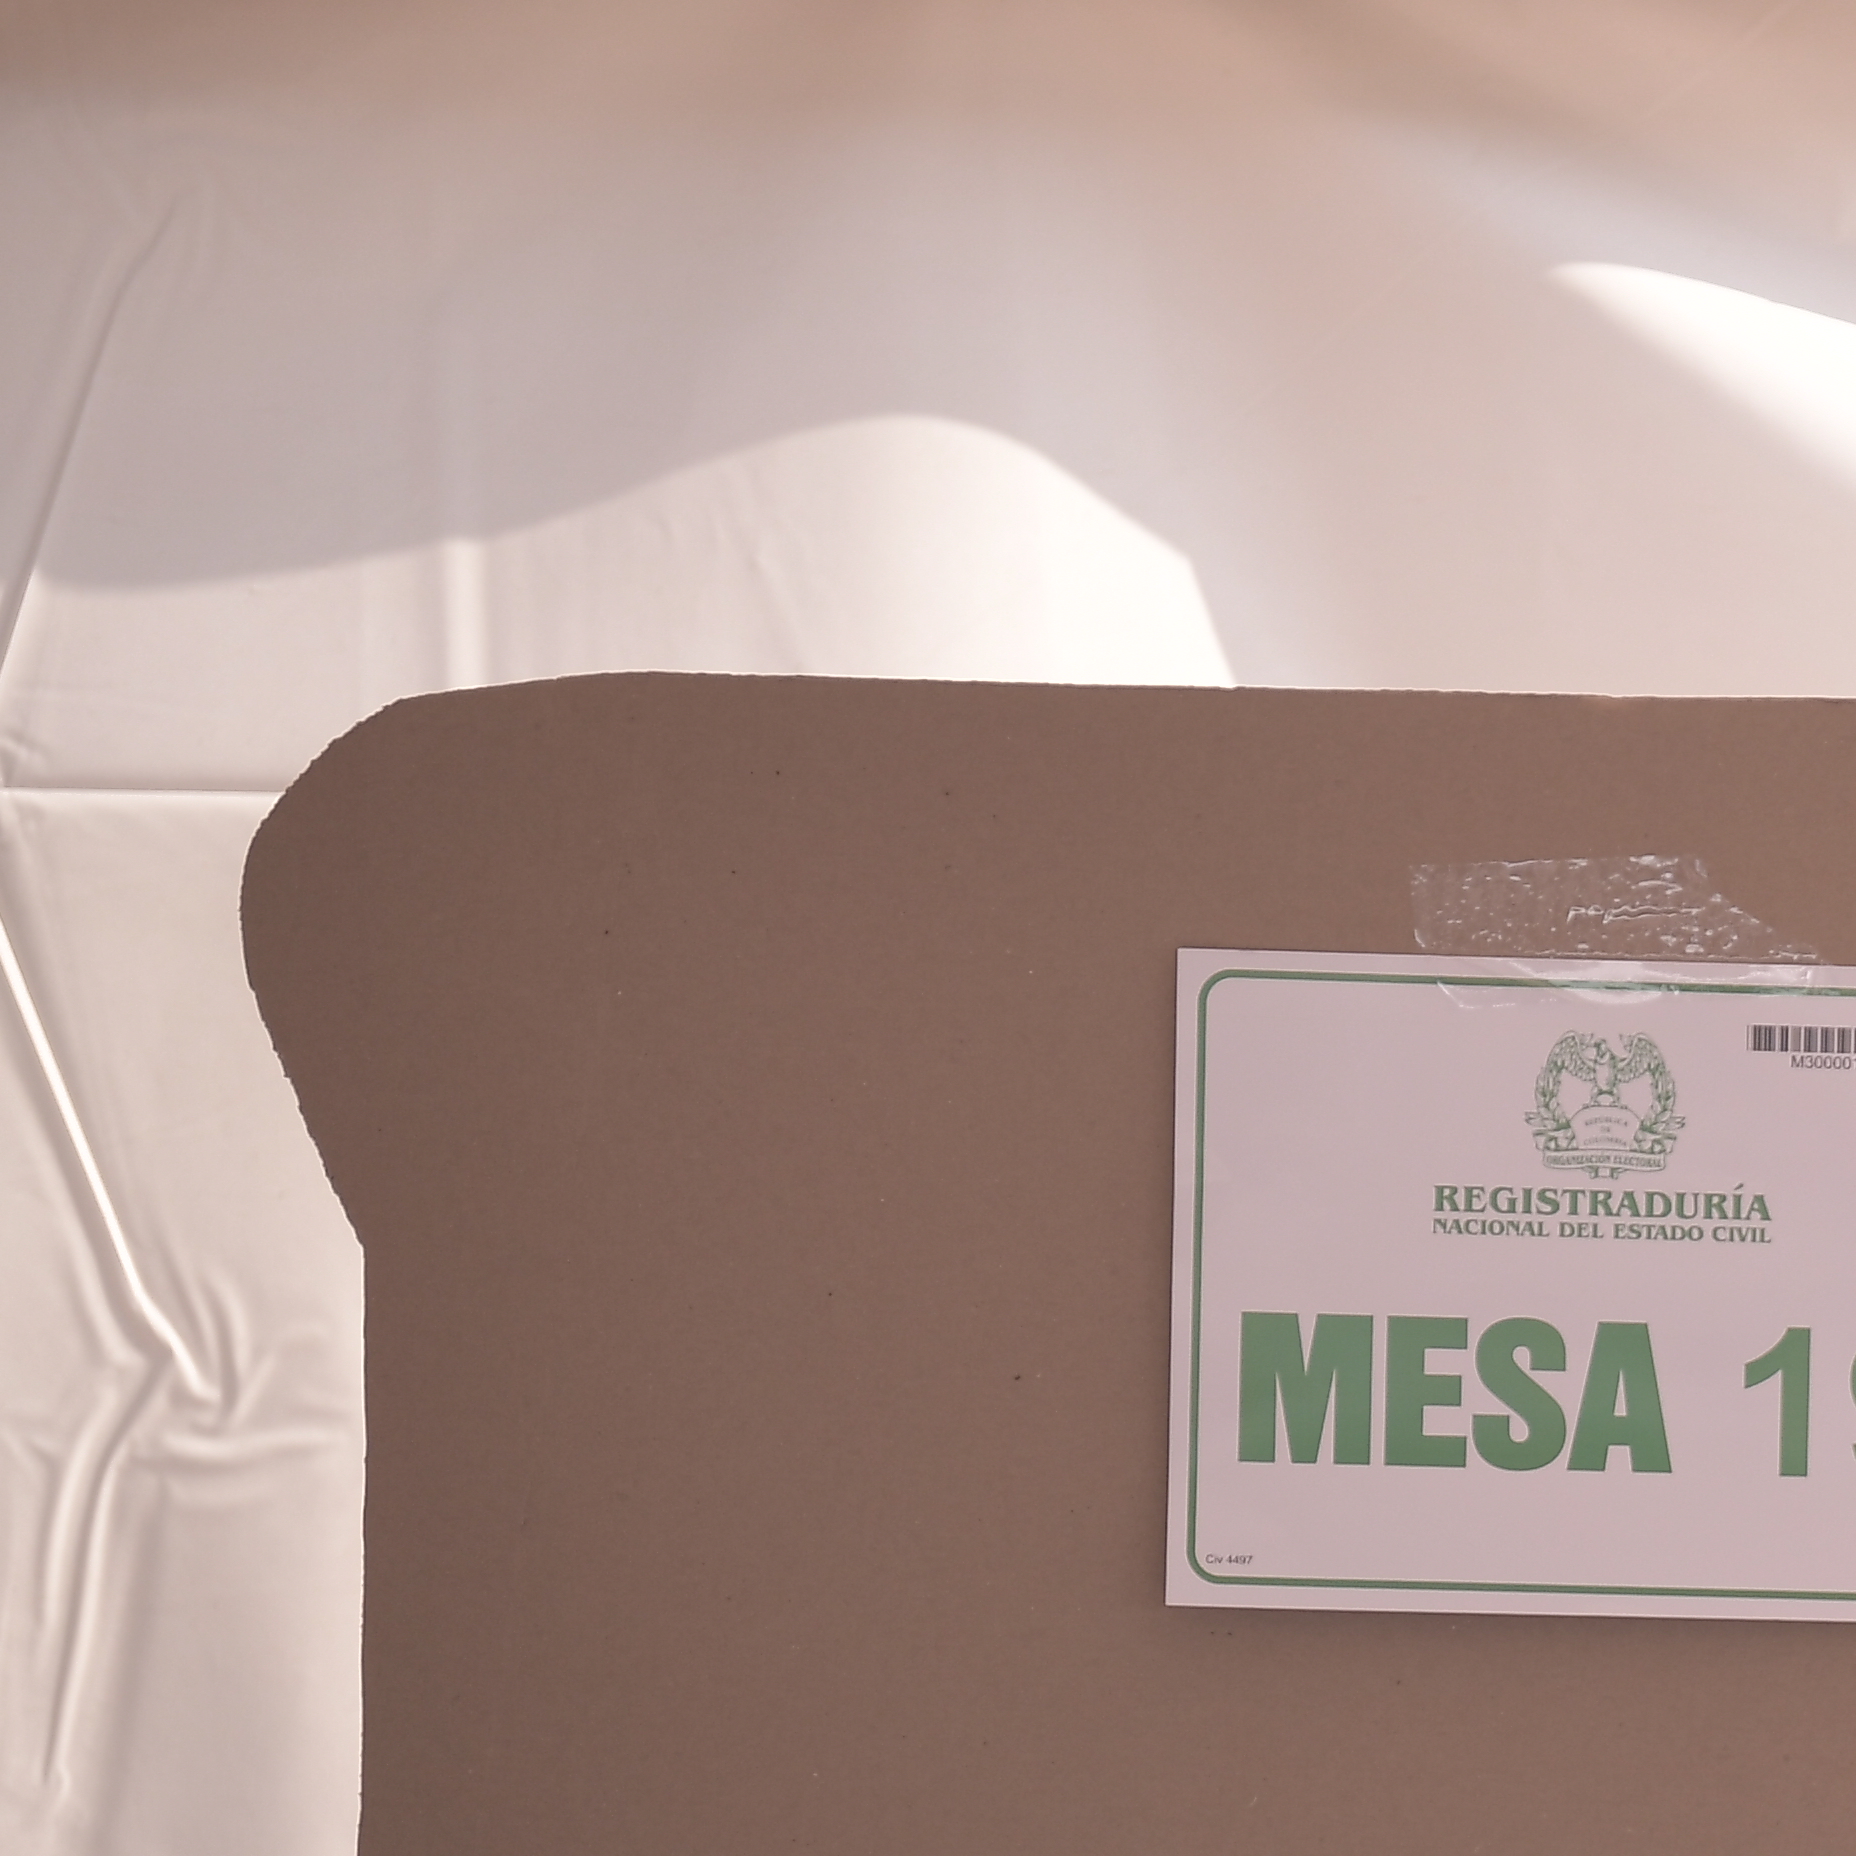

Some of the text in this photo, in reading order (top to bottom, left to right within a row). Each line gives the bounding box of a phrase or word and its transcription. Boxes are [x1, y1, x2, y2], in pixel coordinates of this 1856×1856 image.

[1433, 1182, 1773, 1221] REGISTRADURÍA
[1432, 1218, 1773, 1244] NACIONAL DEL ESTADO CIVIL
[1237, 1310, 1674, 1475] MESA
[1226, 1555, 1253, 1565] 4497
